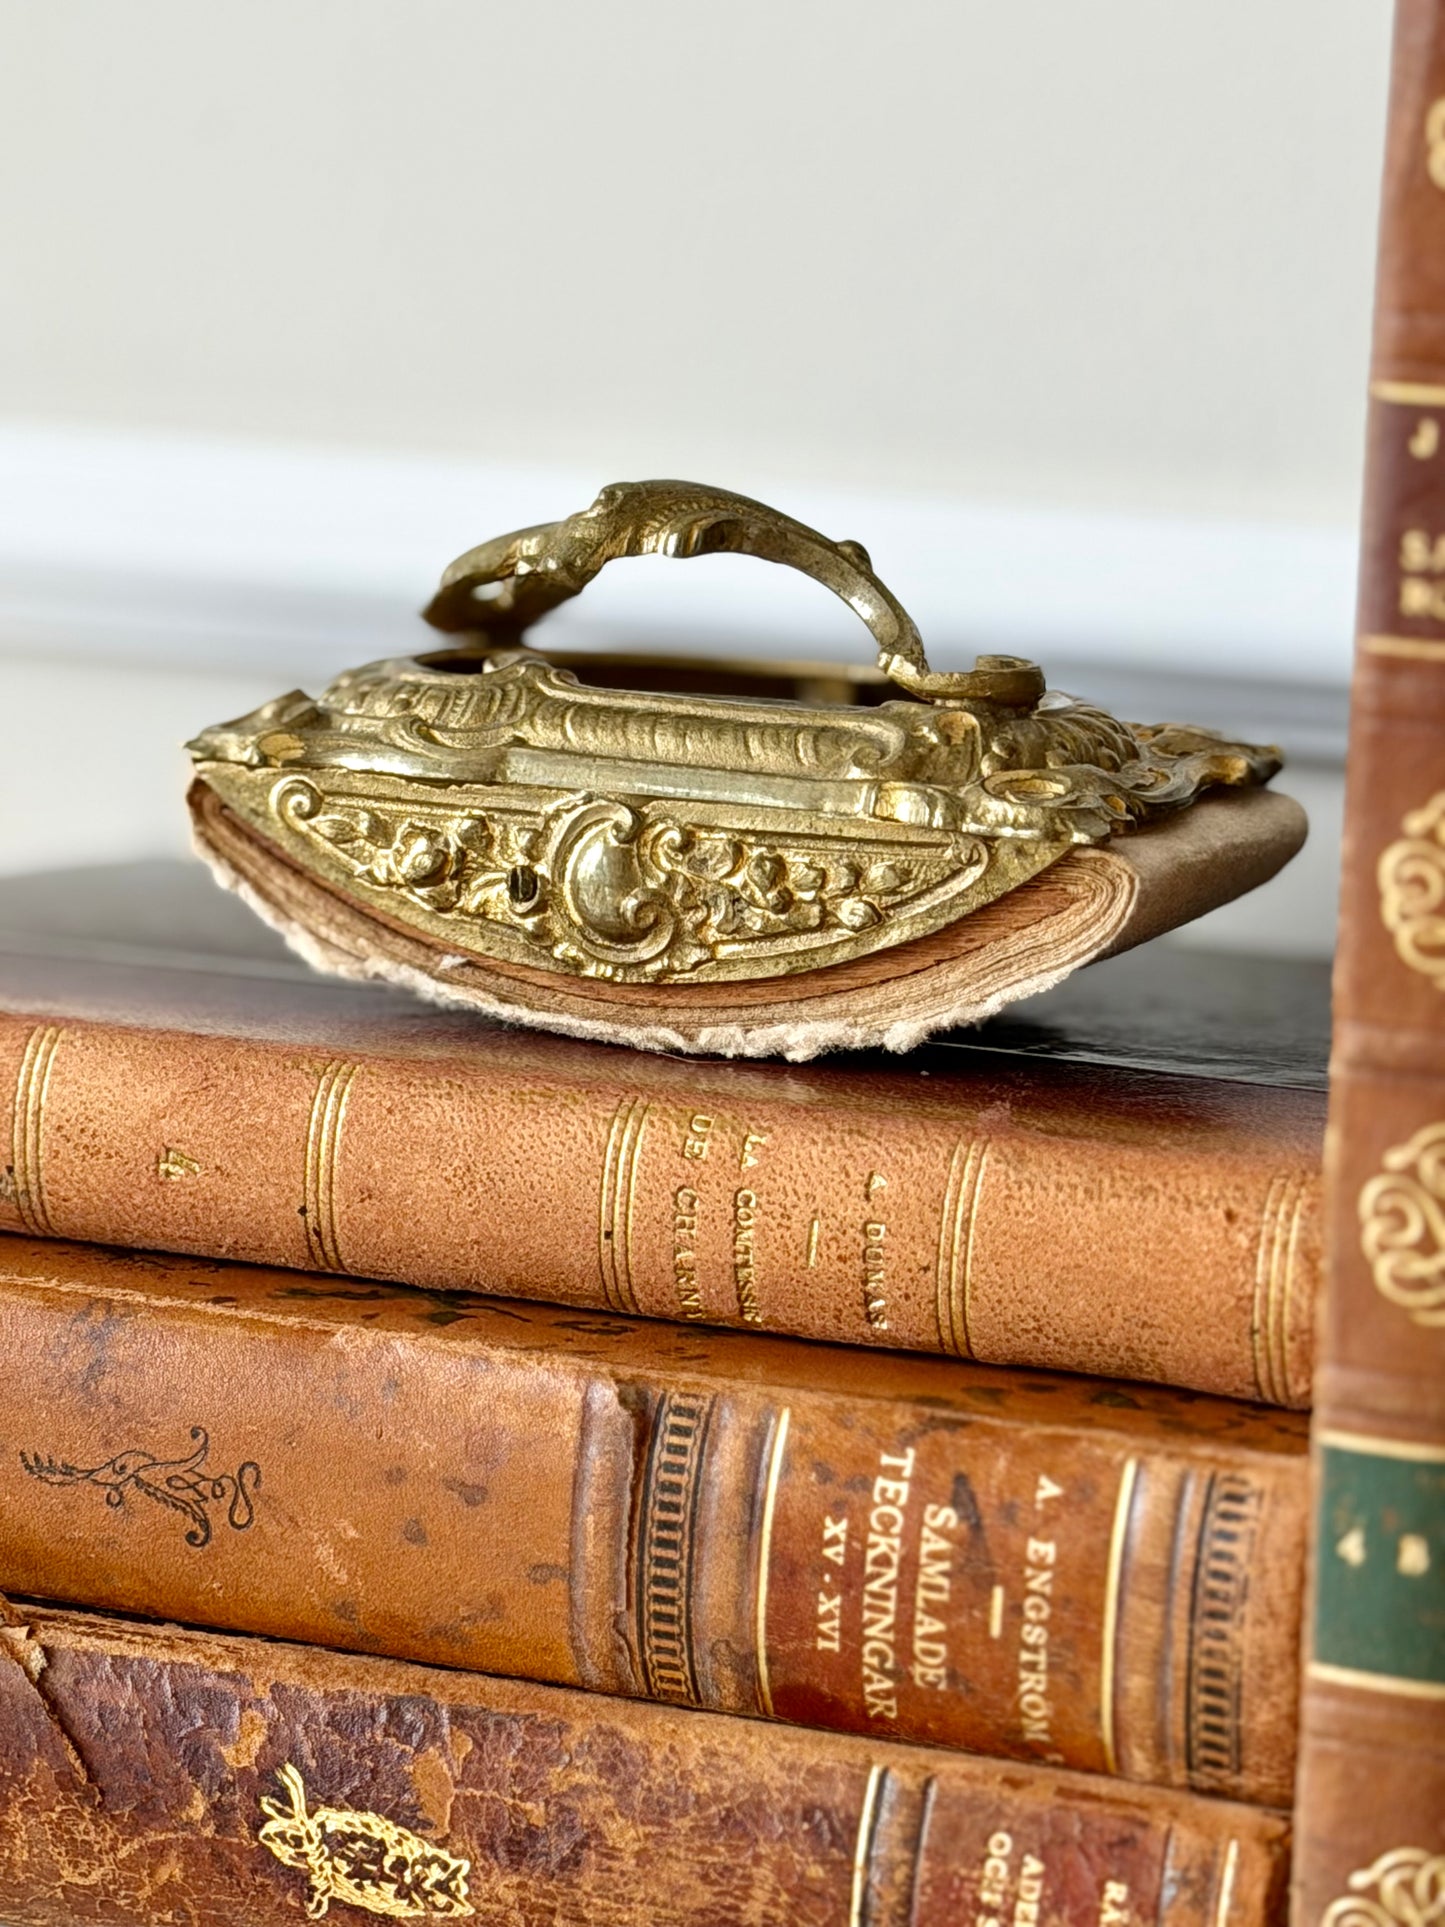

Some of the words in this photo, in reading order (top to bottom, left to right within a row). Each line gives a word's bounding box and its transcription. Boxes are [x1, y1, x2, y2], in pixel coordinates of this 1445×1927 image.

[683, 1113, 716, 1161] DE
[741, 1131, 768, 1170] LA
[1034, 1474, 1064, 1511] A.
[821, 1516, 848, 1565] XV
[860, 1446, 916, 1720] TECKNINGAR
[911, 1502, 958, 1691] SAMLADE
[817, 1593, 843, 1653] XVI
